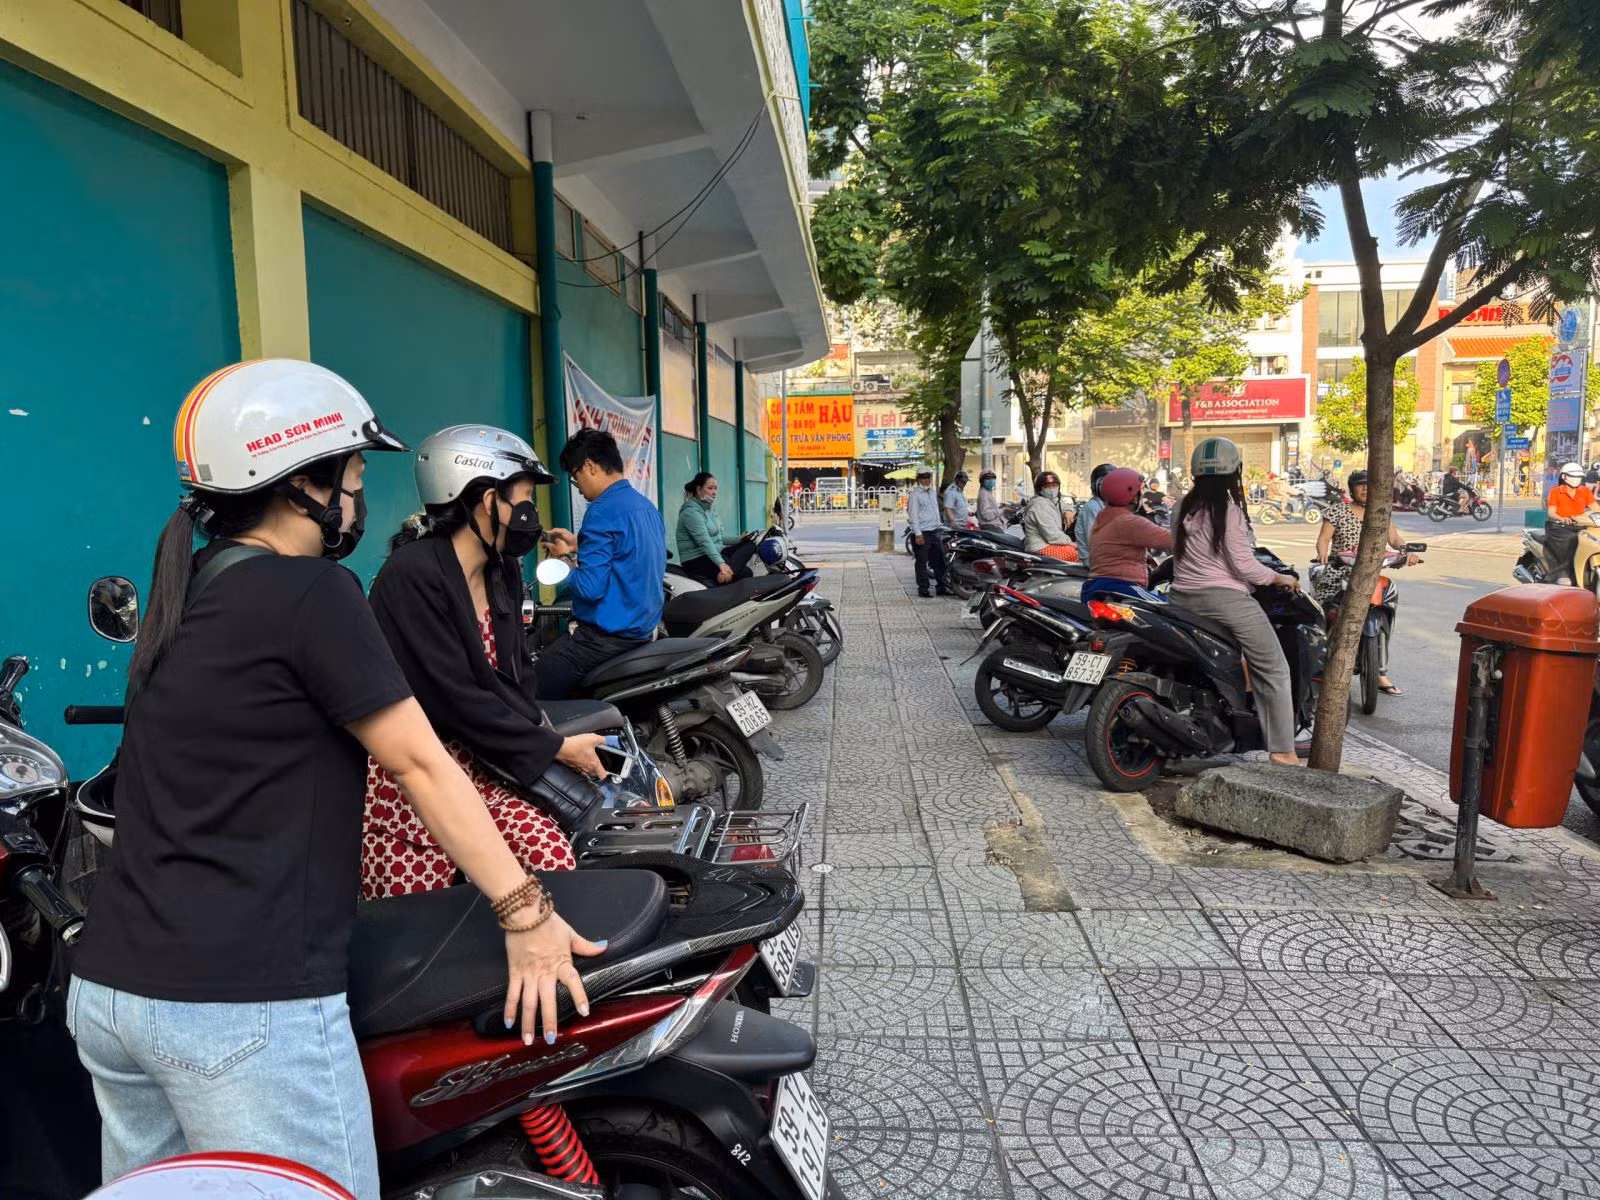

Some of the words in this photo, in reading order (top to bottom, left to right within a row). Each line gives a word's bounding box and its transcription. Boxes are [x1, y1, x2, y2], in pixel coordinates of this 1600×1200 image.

[819, 400, 853, 428] HẬU
[1214, 399, 1280, 408] ASSOCIATION
[246, 433, 282, 452] HEAD
[285, 422, 311, 438] SƠN
[313, 412, 343, 428] MINH
[454, 454, 495, 471] Castrol
[1075, 653, 1103, 668] 59-C1
[1066, 666, 1101, 683] 857.32
[732, 695, 758, 717] 59-H2
[740, 708, 769, 733] 208.65
[730, 1010, 745, 1043] HONDA
[799, 1095, 827, 1199] 197.19
